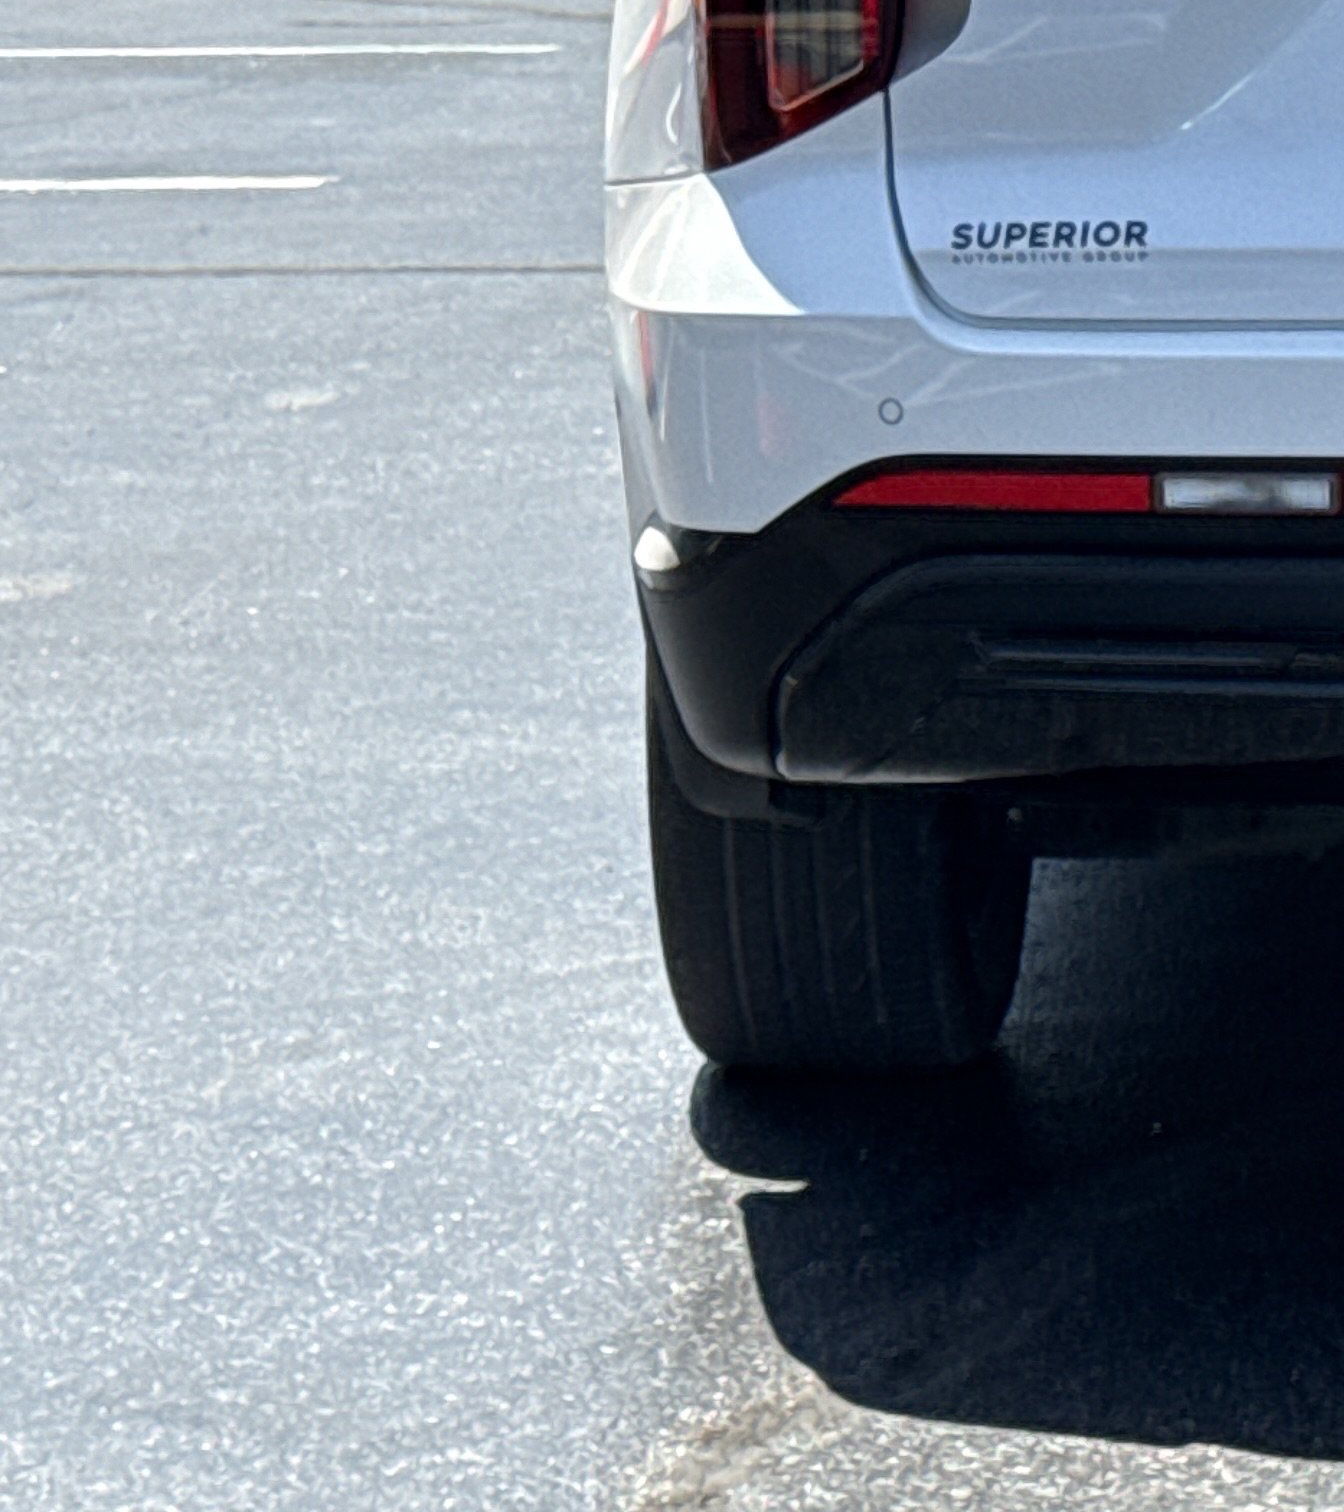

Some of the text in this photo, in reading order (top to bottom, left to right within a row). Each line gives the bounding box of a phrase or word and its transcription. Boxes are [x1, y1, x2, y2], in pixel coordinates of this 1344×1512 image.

[950, 220, 1149, 250] SUPERIOR
[951, 250, 1149, 265] AUTOMOTIVE GROUP
